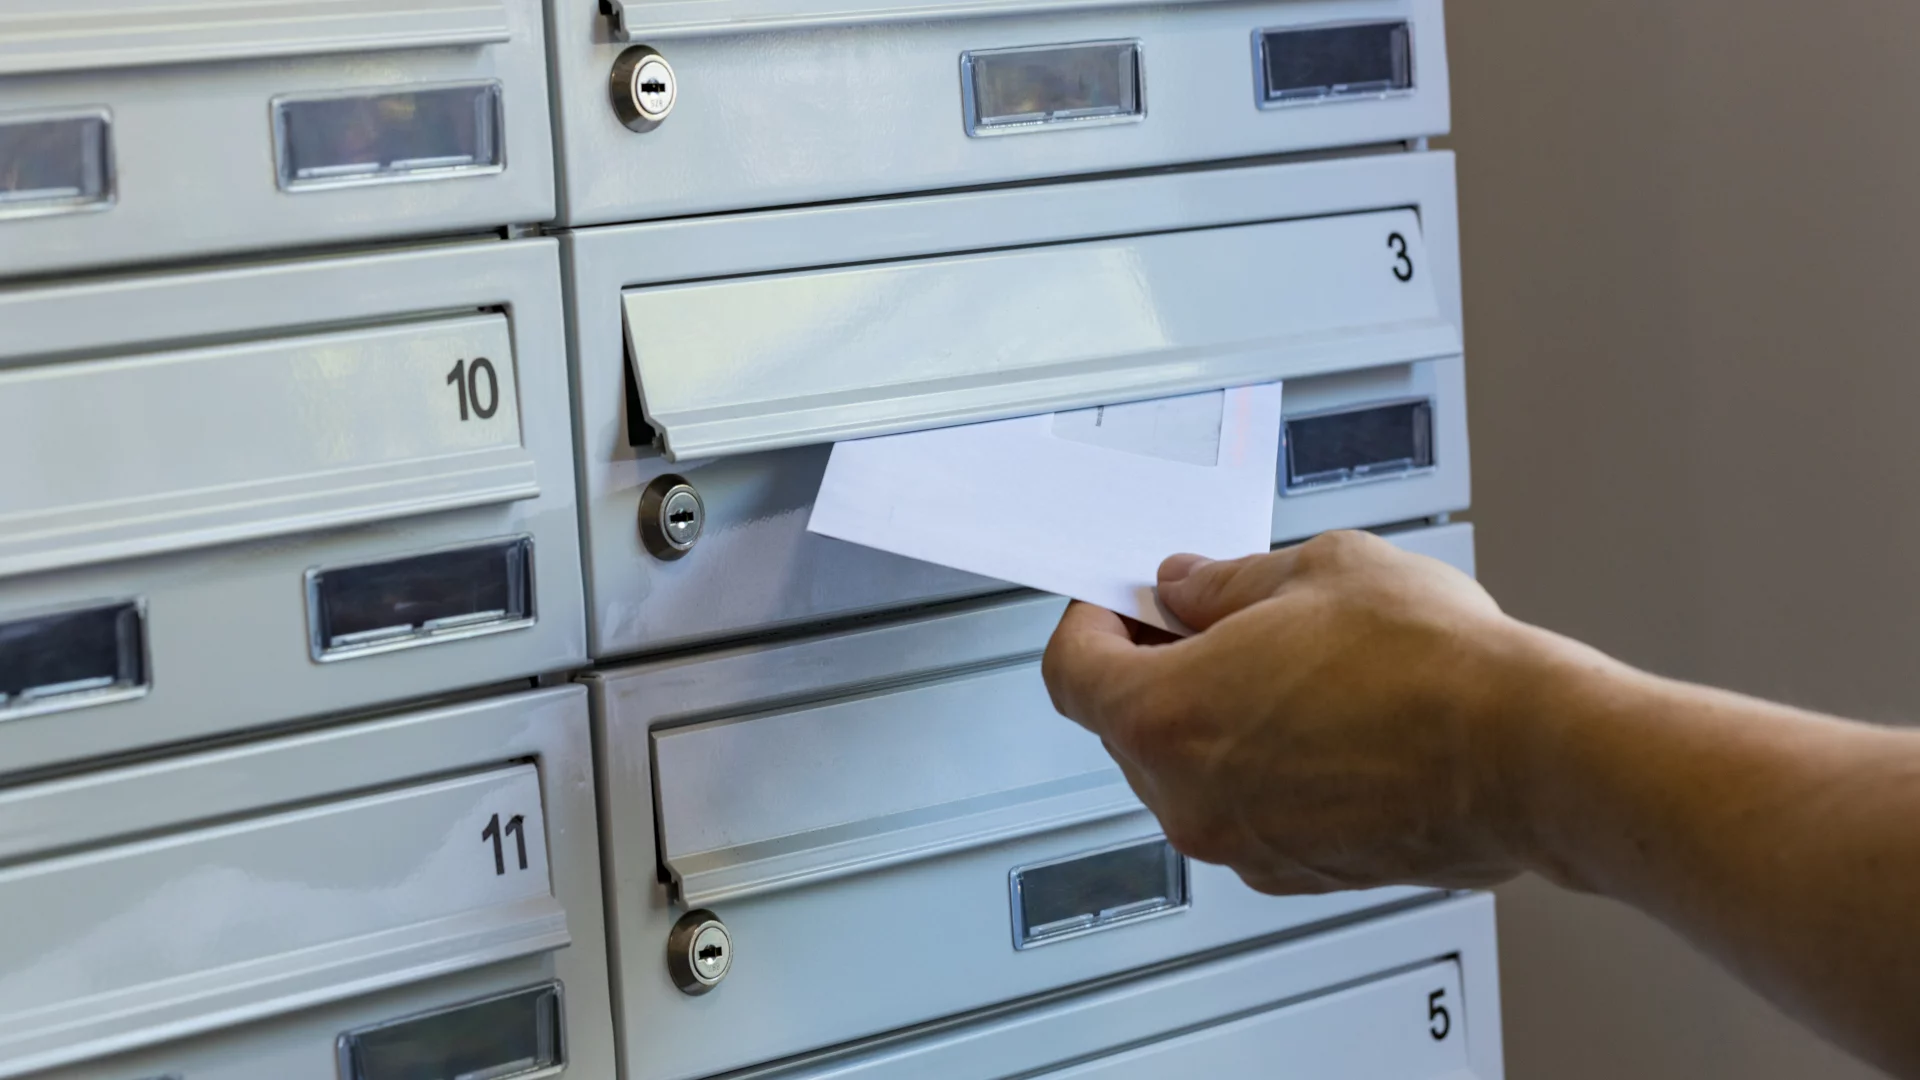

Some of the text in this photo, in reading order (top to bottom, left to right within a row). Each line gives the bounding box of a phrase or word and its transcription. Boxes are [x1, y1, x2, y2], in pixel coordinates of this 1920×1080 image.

[1387, 232, 1413, 283] 3
[447, 357, 499, 421] 10
[481, 813, 528, 876] 11
[1428, 987, 1451, 1042] 5
